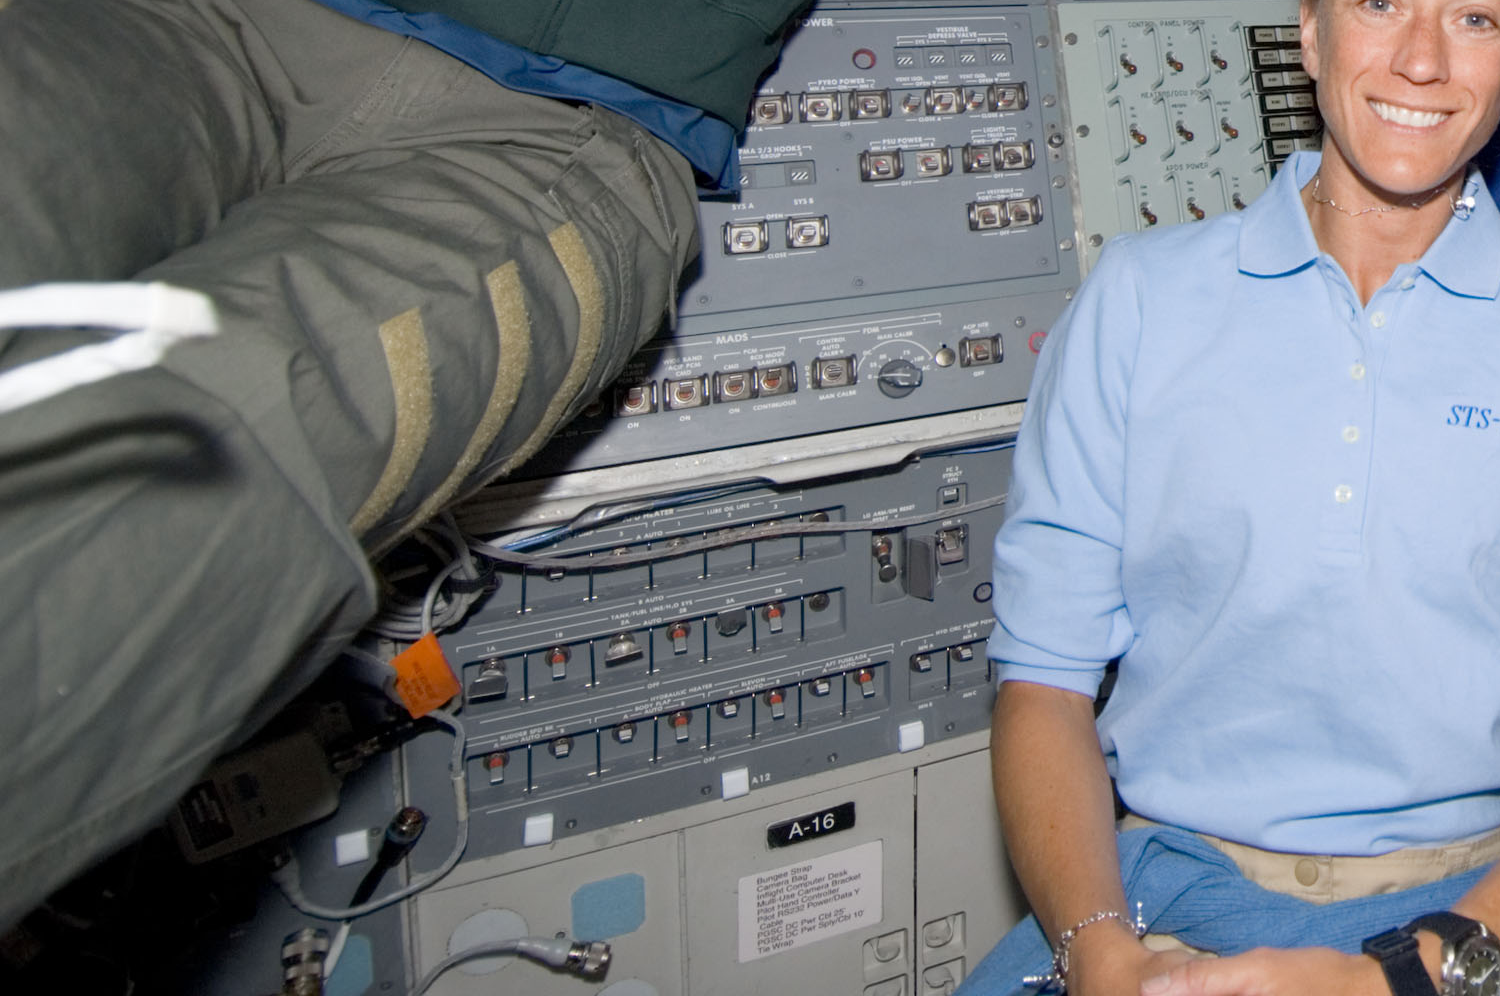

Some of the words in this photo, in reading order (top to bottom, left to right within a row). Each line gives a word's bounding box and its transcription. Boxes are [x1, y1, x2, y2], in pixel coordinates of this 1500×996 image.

[774, 145, 801, 153] HOOKS
[767, 252, 787, 260] CLOSE
[716, 332, 749, 346] MADS
[753, 399, 797, 412] CONTINUOUS
[706, 507, 722, 516] LUBE
[724, 504, 735, 514] OIL
[737, 502, 751, 512] LINE
[643, 530, 663, 539] AUTO
[644, 595, 665, 604] AUTO
[611, 606, 648, 621] TANK/FUEL
[681, 599, 693, 607] SYS
[643, 617, 662, 626] AUTO
[825, 660, 838, 669] AFT
[838, 653, 868, 665] FUSELAGE
[838, 661, 856, 671] AUTO
[740, 677, 766, 687] ELEVON
[746, 684, 764, 693] AUTO
[650, 688, 687, 702] HYDRAULIC
[688, 683, 713, 694] HEATER
[634, 703, 653, 712] BODY
[654, 699, 672, 707] FLAP
[644, 706, 663, 715] AUTO
[500, 730, 528, 741] RUDDER
[520, 733, 540, 742] AUTO
[703, 755, 717, 764] OFF
[751, 773, 771, 784] A12
[788, 812, 835, 840] A-16
[756, 871, 788, 885] Bungee
[791, 864, 813, 876] Strap
[756, 880, 789, 893] Camera
[791, 874, 808, 885] Bag
[756, 887, 784, 901] Inflight
[786, 876, 825, 895] Computer
[828, 869, 848, 881] Desk
[757, 893, 795, 908] Multi-Use
[797, 882, 829, 897] Camera
[831, 873, 861, 886] Bracket
[757, 906, 775, 916] Pilot
[777, 900, 799, 911] Hand
[801, 888, 840, 904] Controller
[757, 912, 775, 923] Pilot
[777, 904, 805, 918] RS232
[807, 892, 853, 909] Power/Data
[757, 926, 783, 939] PGSC
[785, 922, 798, 930] DC
[801, 917, 816, 926] Pwr
[818, 911, 832, 921] Cbl
[757, 933, 783, 947] PGSC
[785, 930, 798, 940] DC
[801, 924, 817, 935] Pwr
[818, 914, 851, 929] Sply/Cbl
[760, 919, 784, 930] Cable
[757, 945, 770, 954] Tie
[772, 939, 794, 951] Wrap
